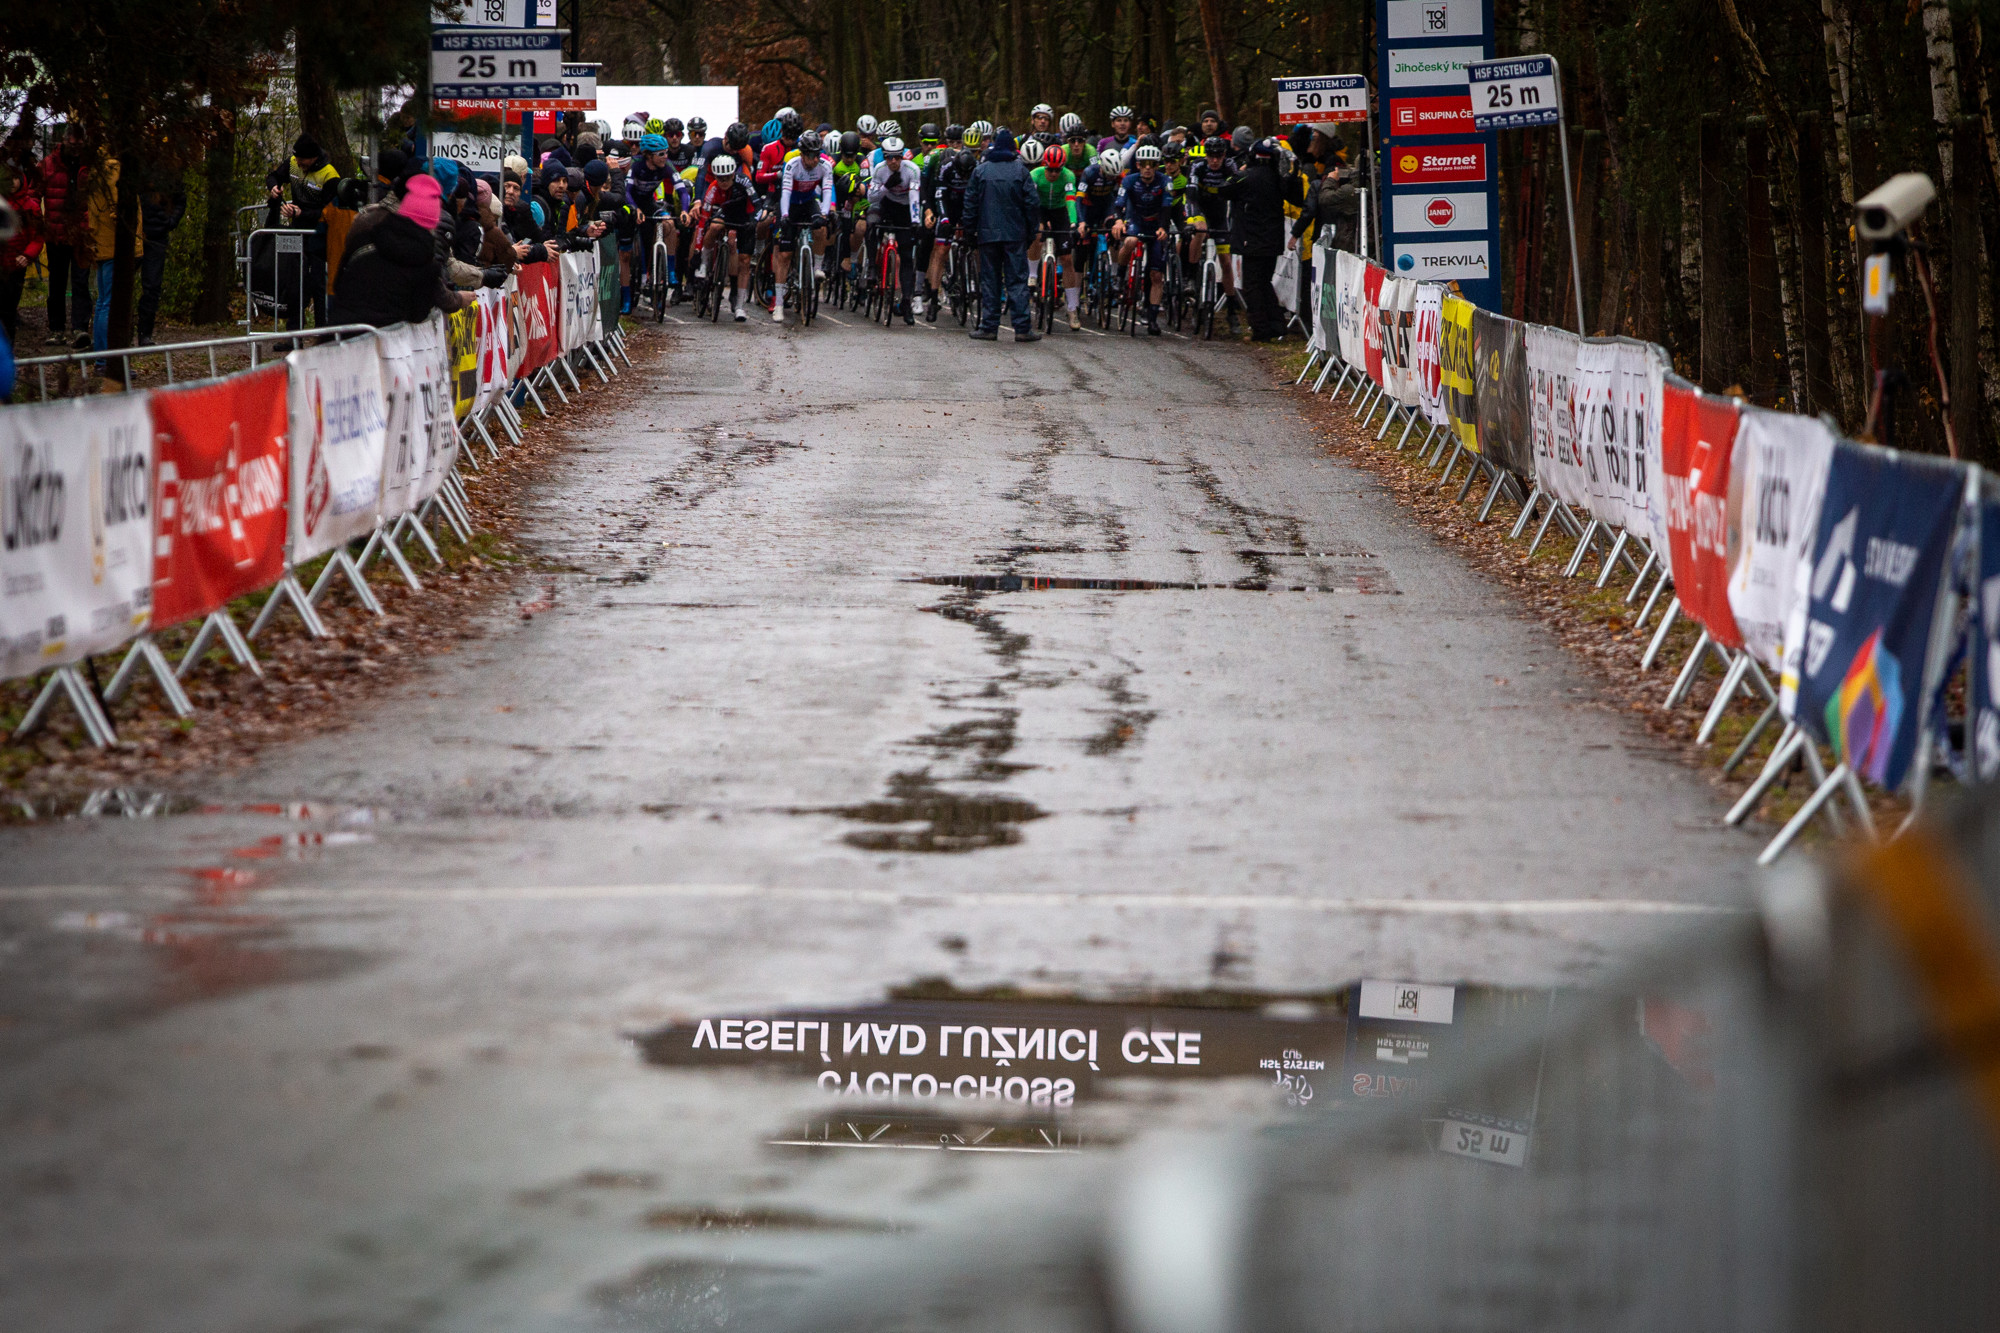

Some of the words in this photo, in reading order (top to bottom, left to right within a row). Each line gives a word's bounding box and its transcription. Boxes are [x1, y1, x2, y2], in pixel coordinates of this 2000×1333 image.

[484, 10, 504, 22] TOI
[1429, 20, 1446, 30] TOI
[443, 37, 468, 48] HSF
[472, 36, 524, 48] SYSTEM
[525, 36, 549, 48] CUP
[458, 55, 496, 78] 25
[508, 58, 537, 77] m
[571, 67, 588, 76] CUP
[1394, 61, 1449, 73] Jihočeský
[1475, 67, 1491, 79] HSF
[1493, 63, 1527, 77] SYSTEM
[1528, 62, 1544, 73] CUP
[1285, 81, 1302, 90] HSF
[1305, 80, 1339, 88] SYSTEM
[1340, 79, 1357, 87] CUP
[897, 91, 921, 102] 100
[926, 91, 939, 100] m
[1296, 93, 1322, 109] 50
[1330, 94, 1350, 108] m
[1487, 83, 1513, 108] 25
[1520, 86, 1540, 105] m
[457, 99, 496, 109] SKUPINA
[1419, 111, 1458, 121] SKUPINA
[1422, 154, 1477, 167] Starnet
